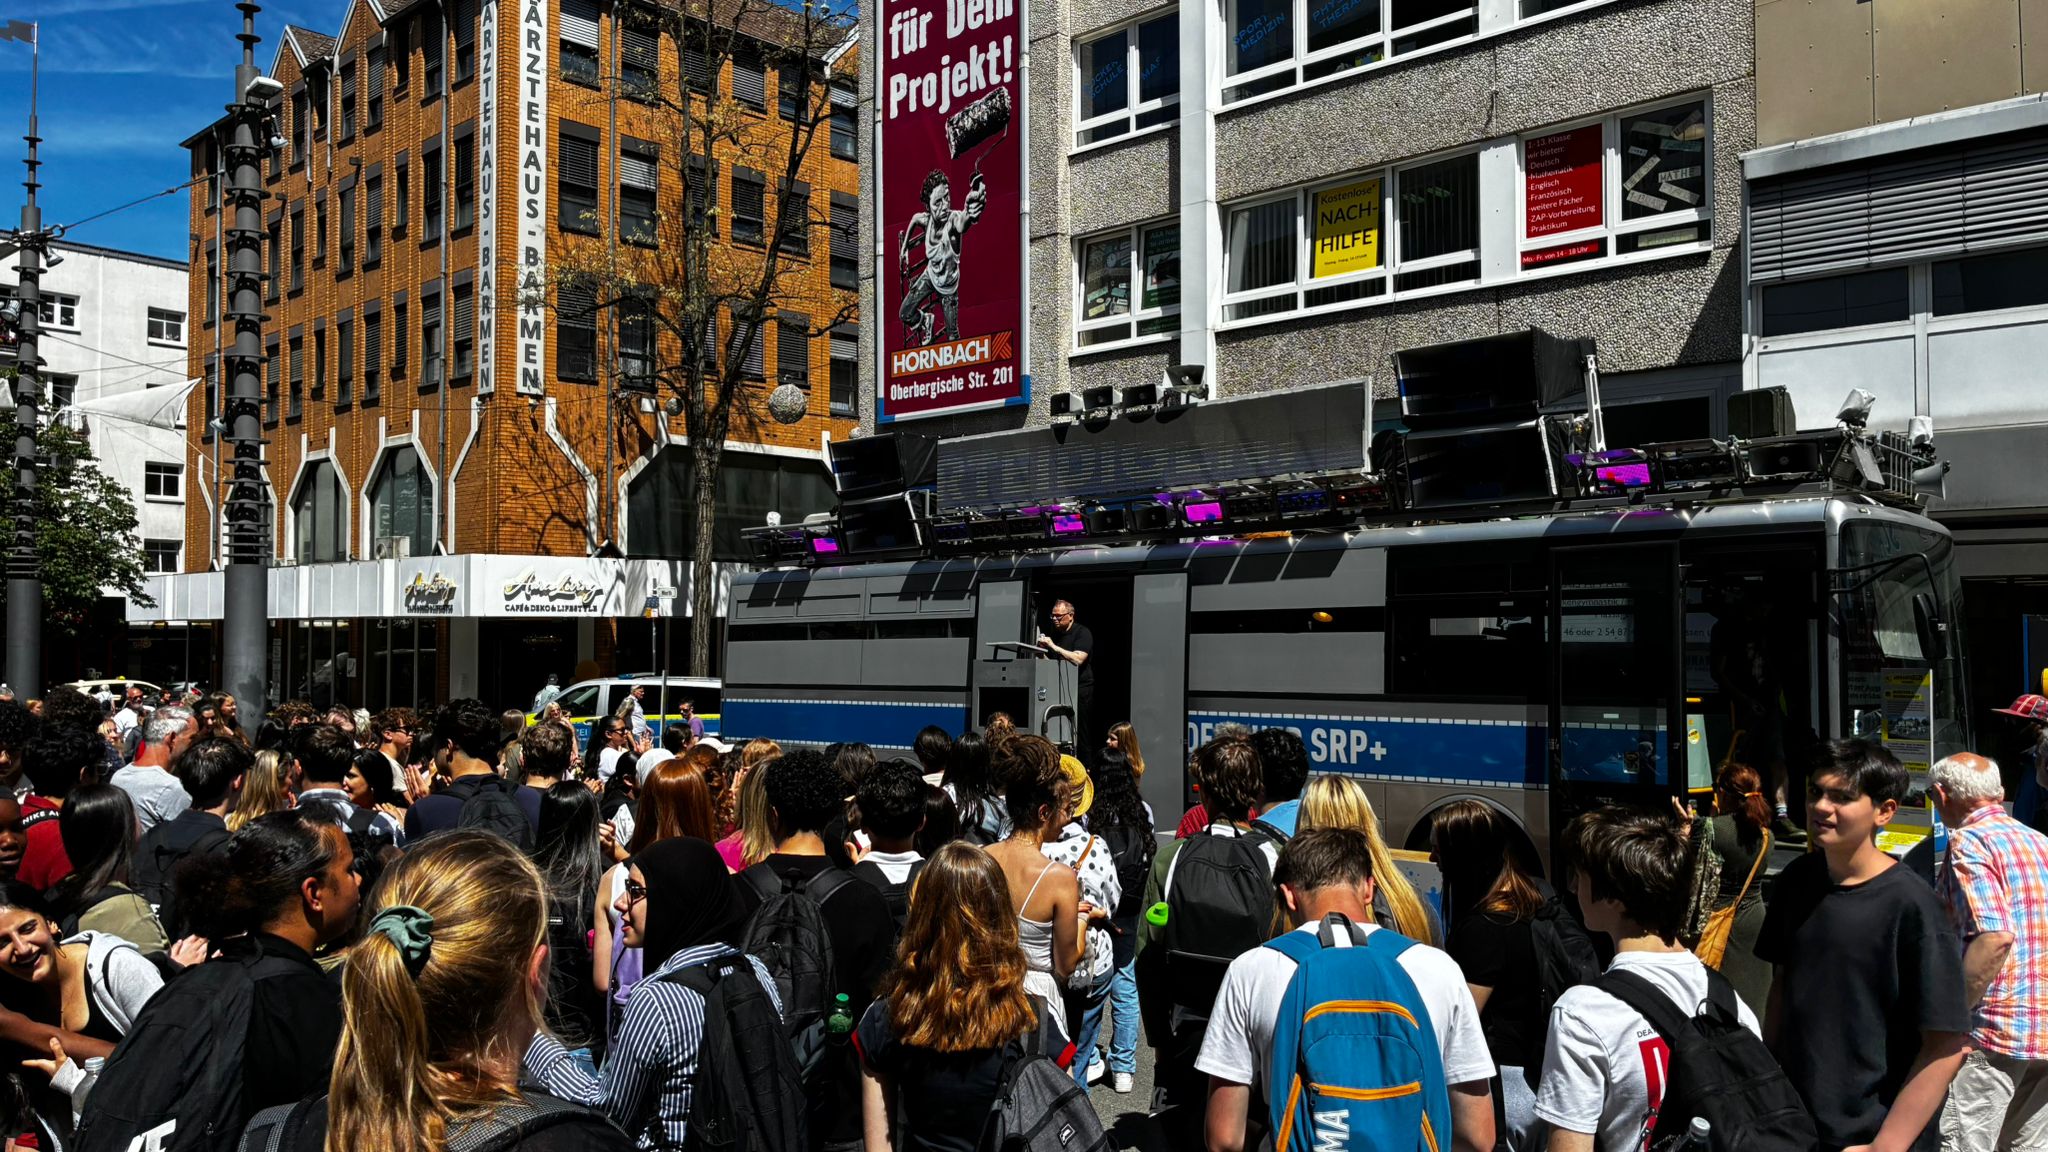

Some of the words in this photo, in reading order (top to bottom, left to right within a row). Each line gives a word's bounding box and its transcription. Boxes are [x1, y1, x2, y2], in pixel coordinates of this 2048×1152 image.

[889, 7, 933, 59] für
[1233, 15, 1269, 45] SPORT
[1240, 12, 1287, 52] MEDIZIN
[889, 35, 1013, 119] Projekt!
[524, 0, 543, 219] ÄRZTEHAUS
[1527, 151, 1538, 160] wir
[1540, 145, 1566, 157] bieten:
[1548, 134, 1572, 145] Klasse
[1660, 166, 1697, 182] MATHE
[1320, 200, 1379, 227] NACH-
[1558, 196, 1584, 207] Fächer
[1320, 227, 1374, 254] HILFE
[1556, 250, 1564, 258] 14
[1577, 246, 1589, 254] Uhr
[480, 246, 491, 389] BARMEN
[520, 246, 541, 389] BARMEN
[893, 338, 989, 374] HORNBACH
[890, 374, 964, 401] Oberbergische
[968, 371, 988, 389] Str.
[992, 365, 1013, 386] 201
[1310, 727, 1387, 765] SRP+
[22, 811, 45, 825] NIKE
